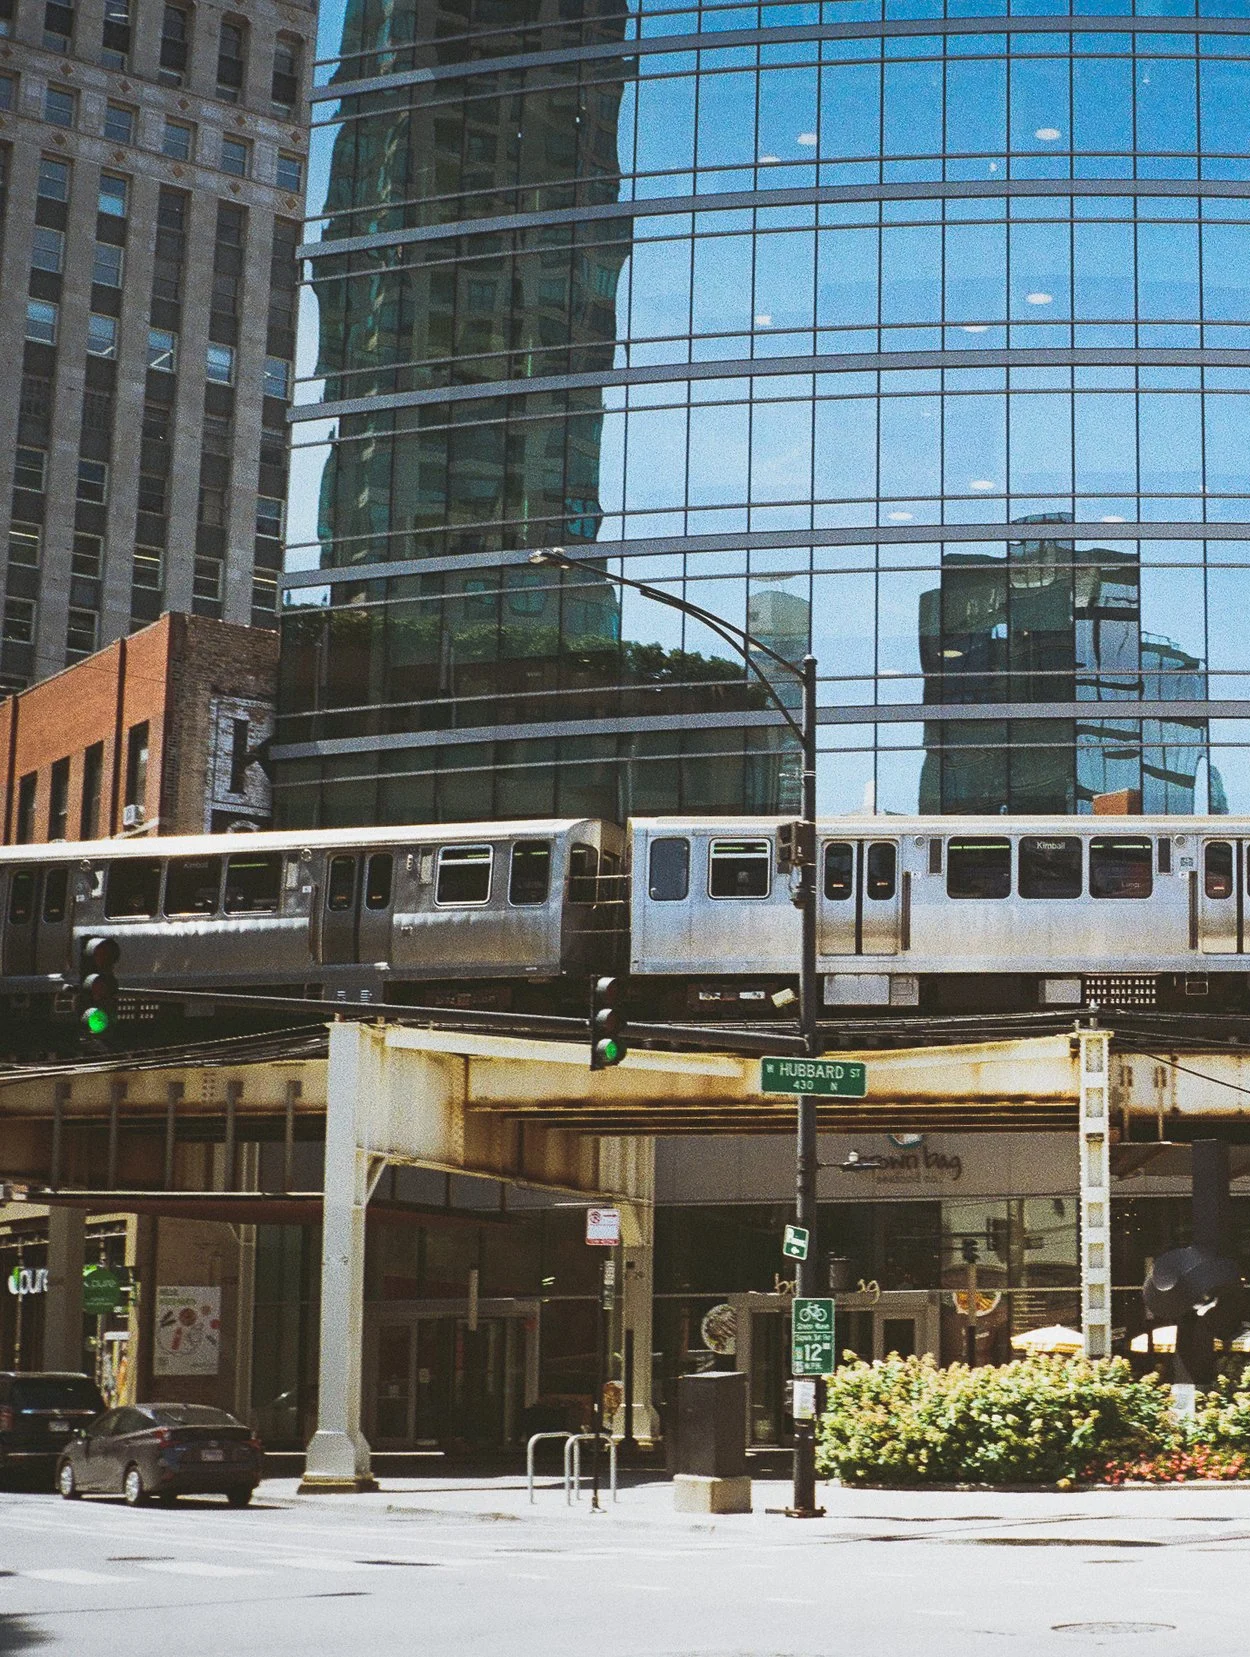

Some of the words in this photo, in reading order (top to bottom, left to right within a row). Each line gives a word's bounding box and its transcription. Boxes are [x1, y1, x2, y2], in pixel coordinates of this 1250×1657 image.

[1036, 841, 1066, 850] Kimball
[780, 1062, 844, 1079] HUBBARD
[850, 1069, 860, 1078] ST
[793, 1080, 814, 1090] 430
[830, 1082, 838, 1091] N
[922, 1144, 962, 1181] bag
[804, 1343, 823, 1361] 12
